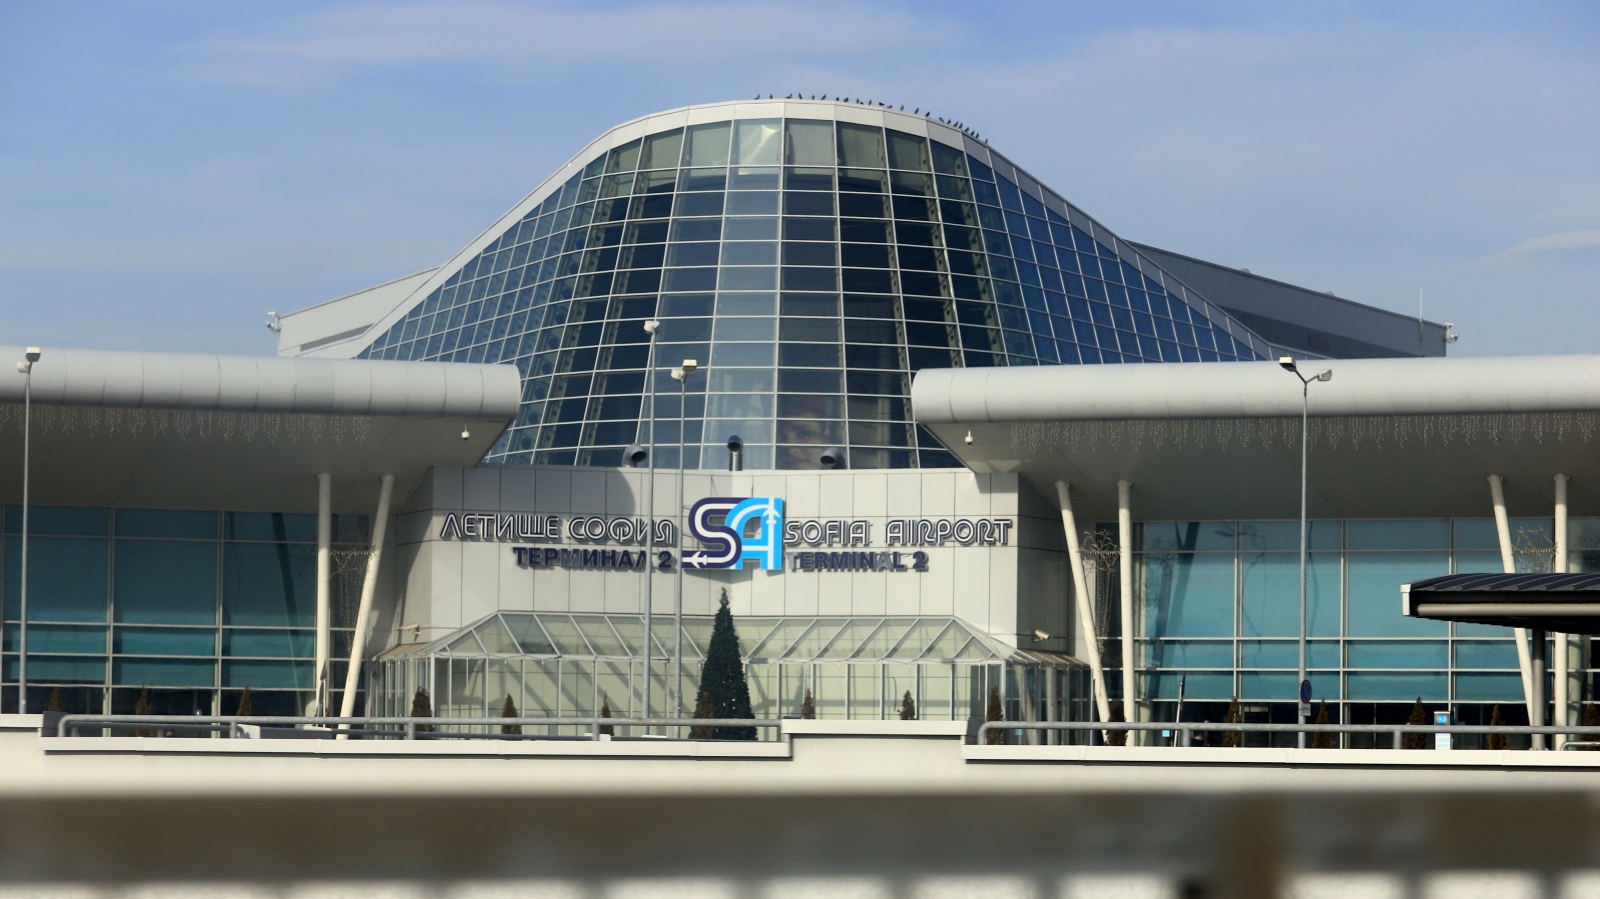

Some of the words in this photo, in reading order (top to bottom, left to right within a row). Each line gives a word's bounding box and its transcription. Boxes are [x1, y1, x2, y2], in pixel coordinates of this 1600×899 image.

[568, 516, 674, 544] СОФИЯ
[682, 497, 782, 570] SA
[784, 519, 870, 545] SOFIA
[885, 518, 1011, 545] AIRPORT
[658, 550, 672, 568] 2
[786, 552, 905, 570] TERMINAL
[912, 551, 927, 570] 2
